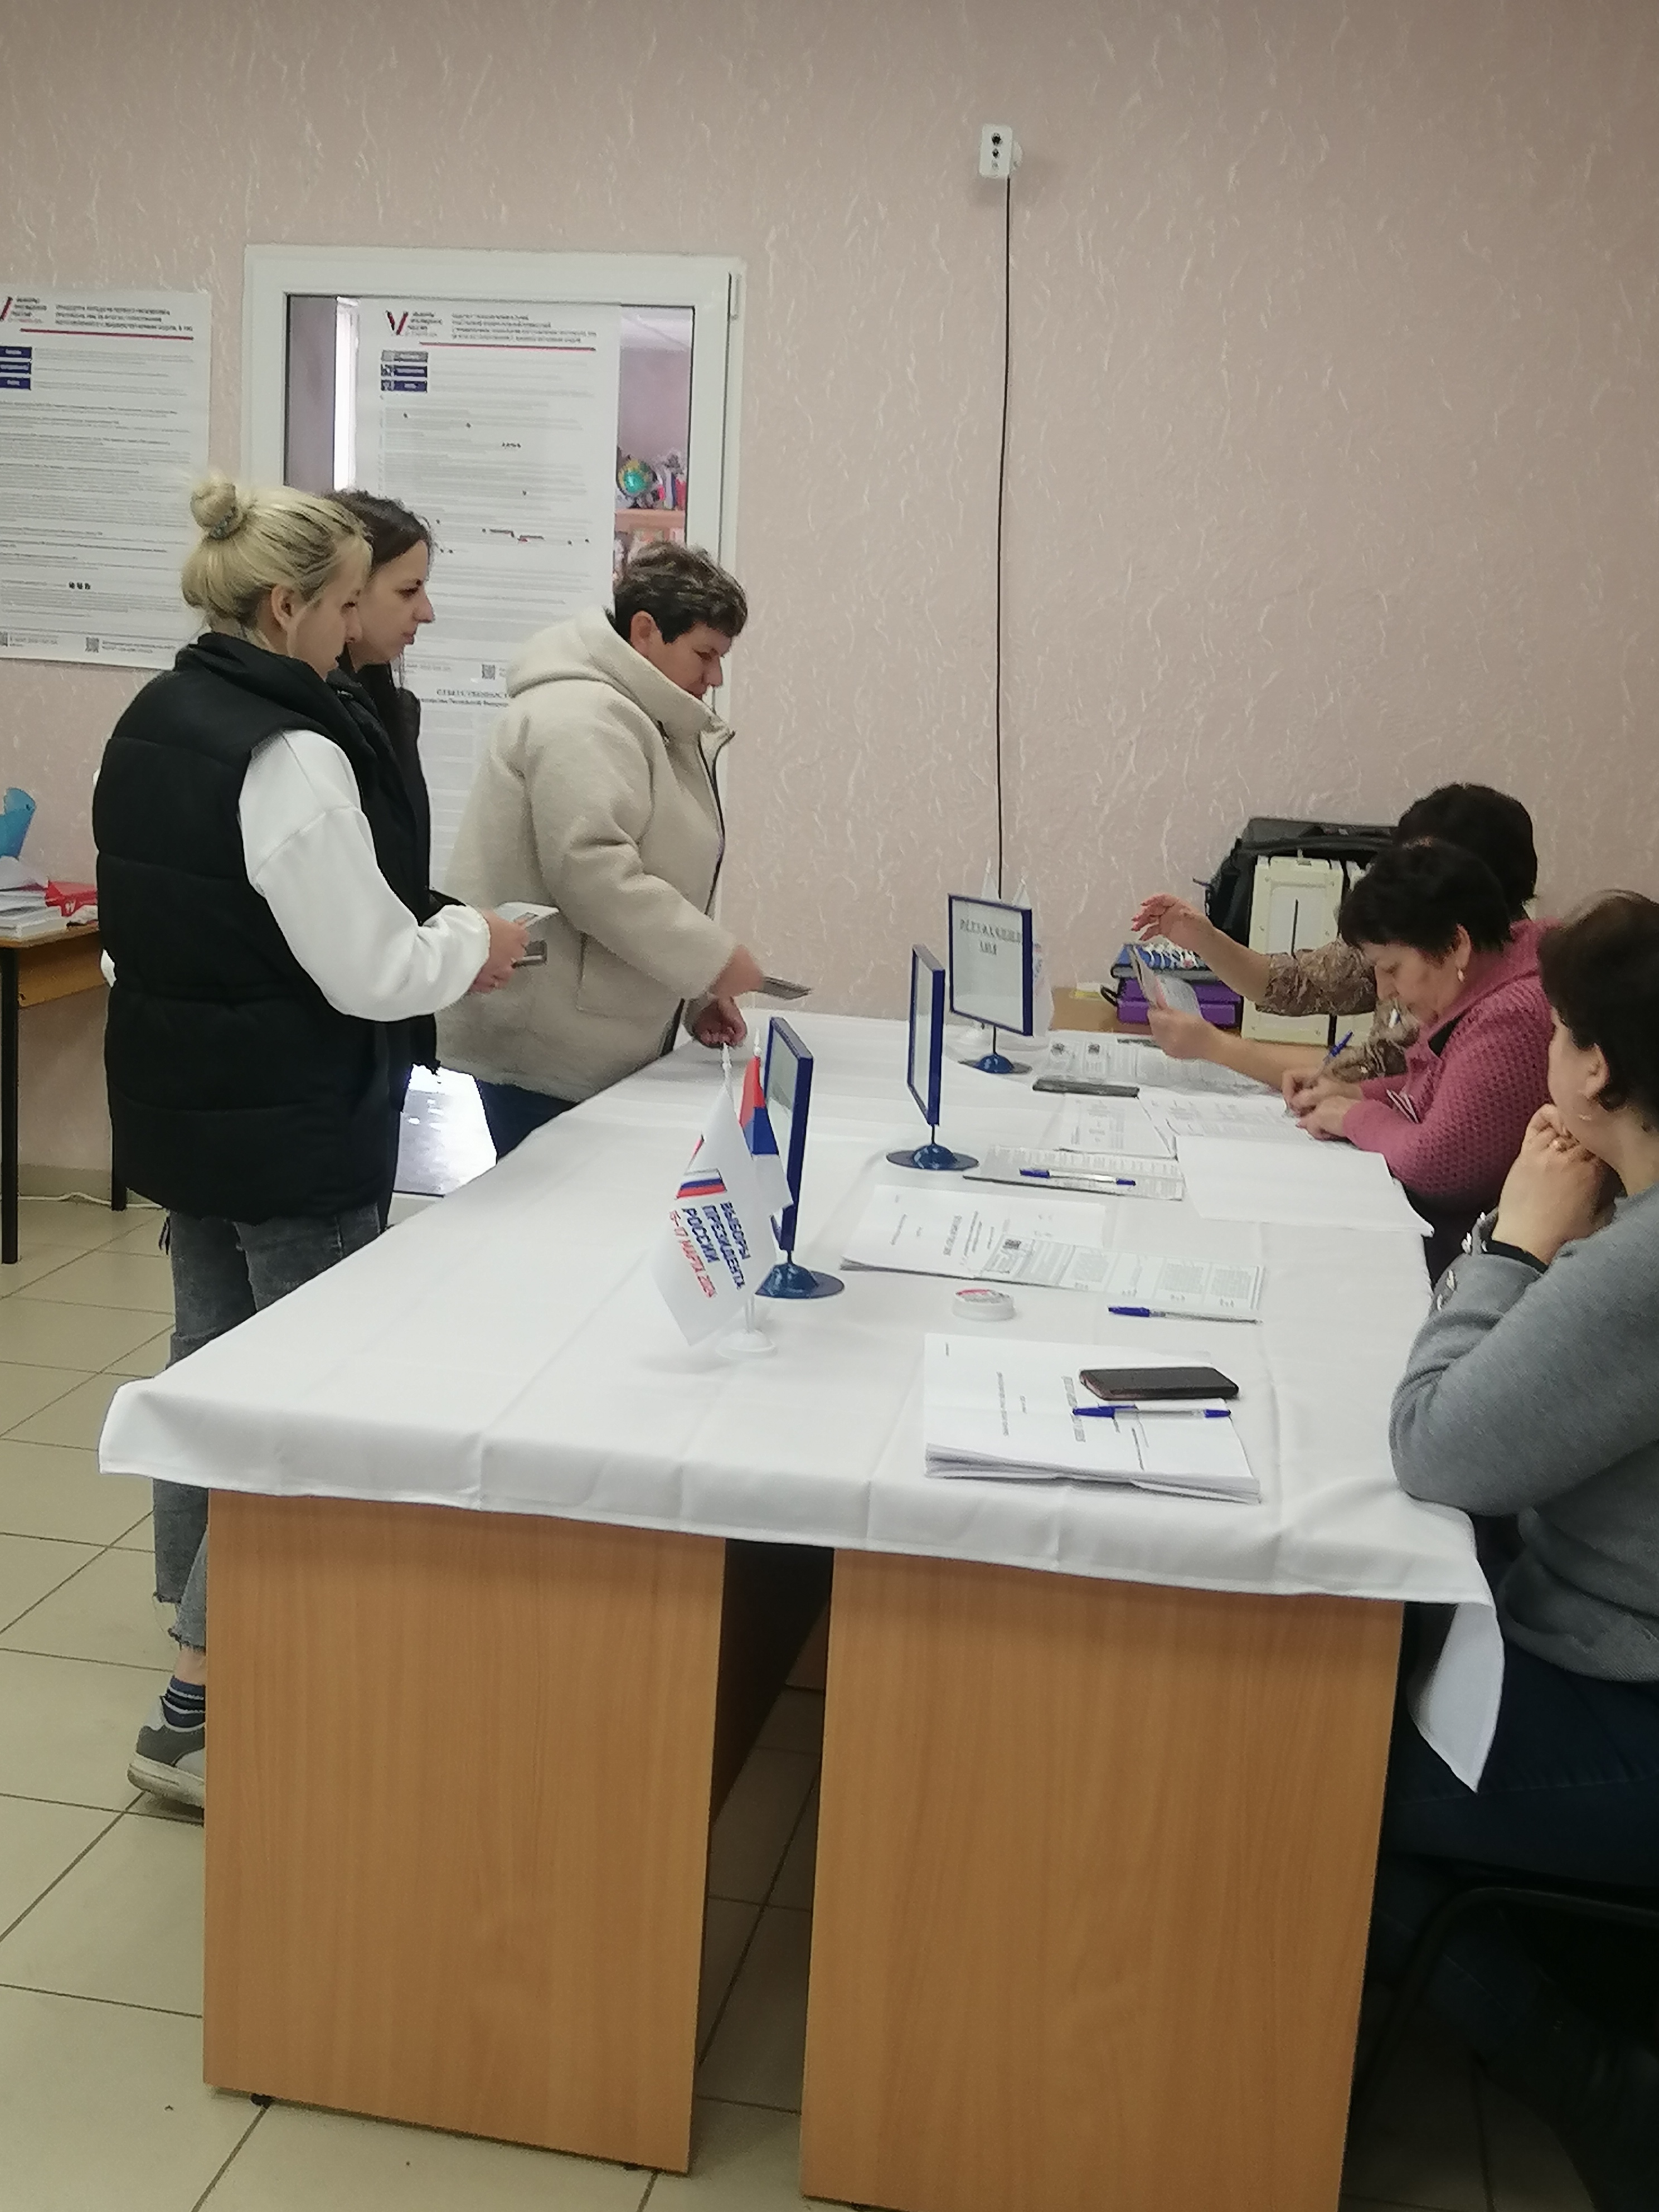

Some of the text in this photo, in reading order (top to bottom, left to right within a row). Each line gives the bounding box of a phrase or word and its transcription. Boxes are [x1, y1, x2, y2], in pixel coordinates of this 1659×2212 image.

[682, 1208, 720, 1263] РОССИИ
[702, 1205, 745, 1289] ПРЕЗИДЕНТА
[720, 1202, 751, 1260] ВЫБОРЫ
